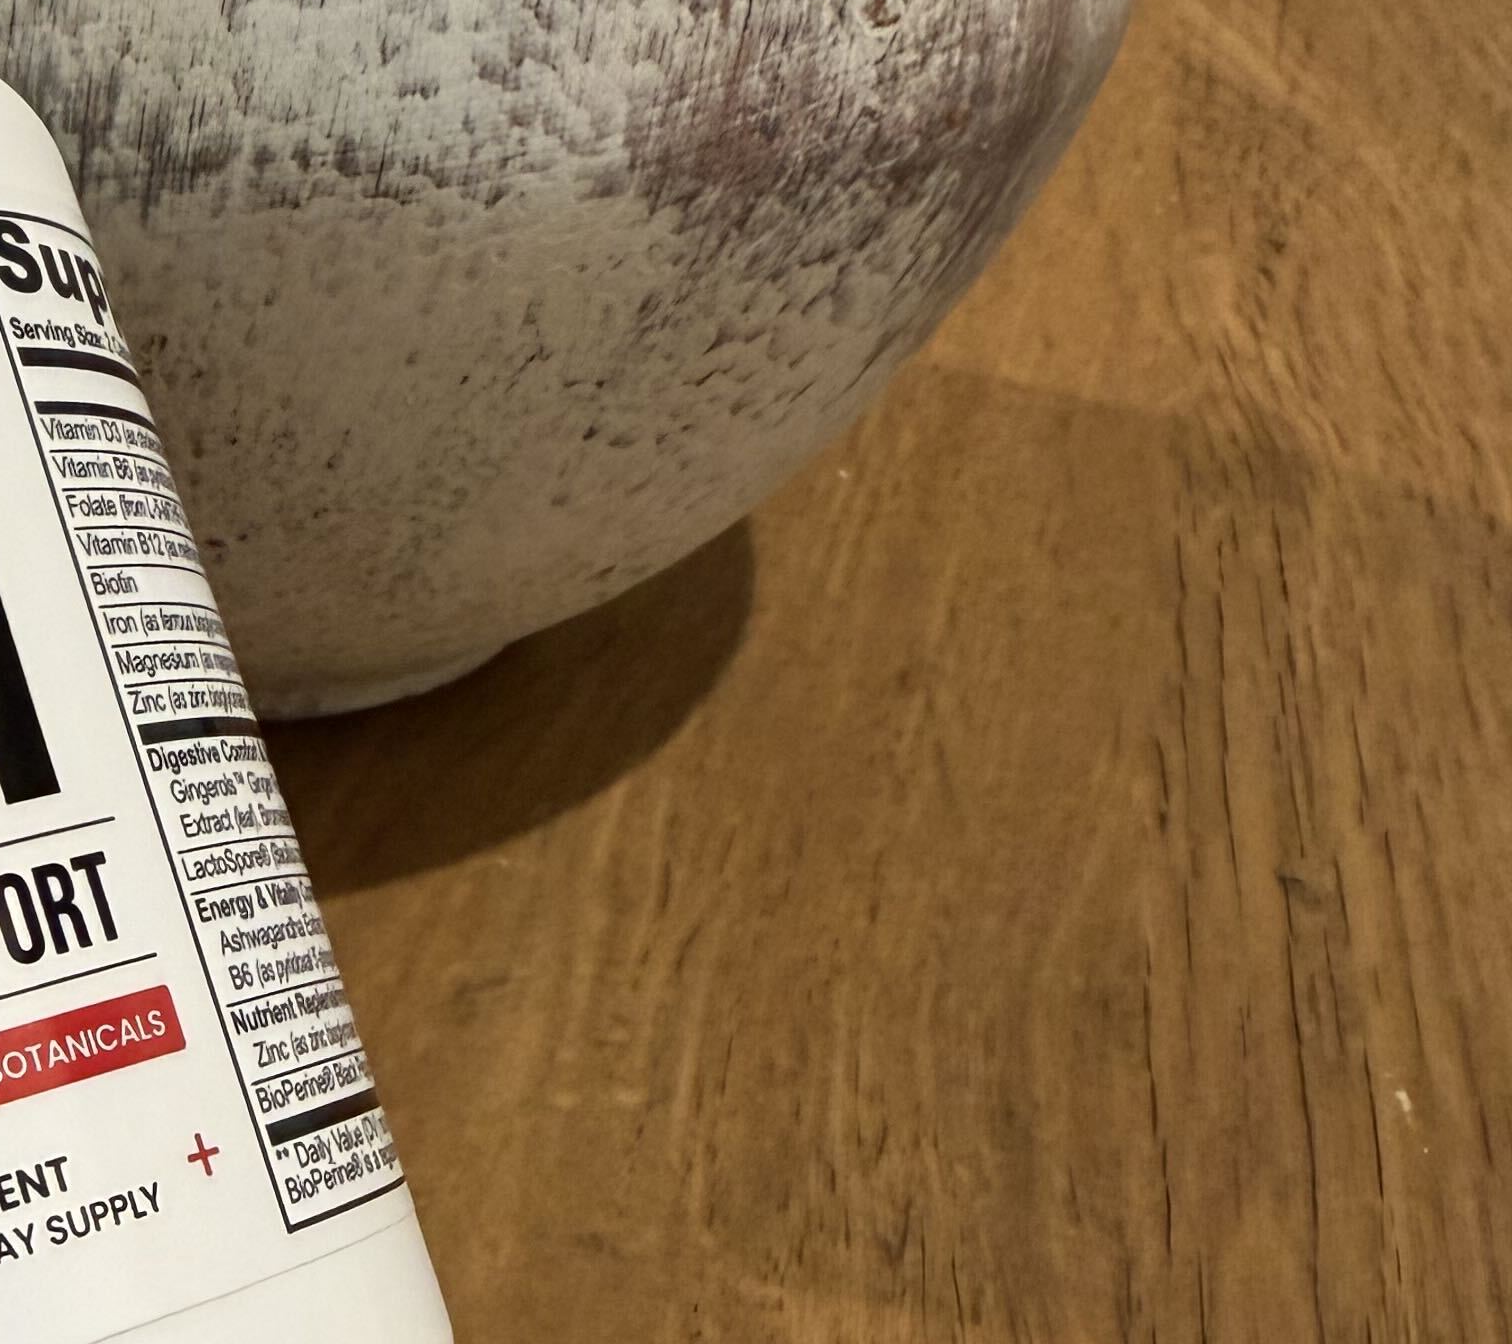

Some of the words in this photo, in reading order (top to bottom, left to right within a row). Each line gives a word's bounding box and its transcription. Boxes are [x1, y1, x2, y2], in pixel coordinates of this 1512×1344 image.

[9, 316, 76, 348] Serving
[40, 416, 101, 442] Vitamin
[101, 418, 122, 444] D3
[52, 454, 115, 479] Vitamin
[65, 493, 118, 518] Folate
[76, 530, 139, 557] Vitamin
[137, 531, 165, 557] B12
[90, 570, 139, 596] Biotin
[103, 611, 139, 636] Iron
[115, 646, 200, 678] Magnesium
[127, 690, 167, 715] Zinc
[146, 741, 221, 775] Digestive
[179, 808, 236, 838] Extract
[194, 893, 256, 924] Energy
[228, 961, 255, 991] B6
[230, 996, 298, 1036] Nutrient
[252, 1040, 290, 1069] Zinc
[292, 1134, 337, 1169] Daily
[45, 1180, 160, 1246] SUPPLY
